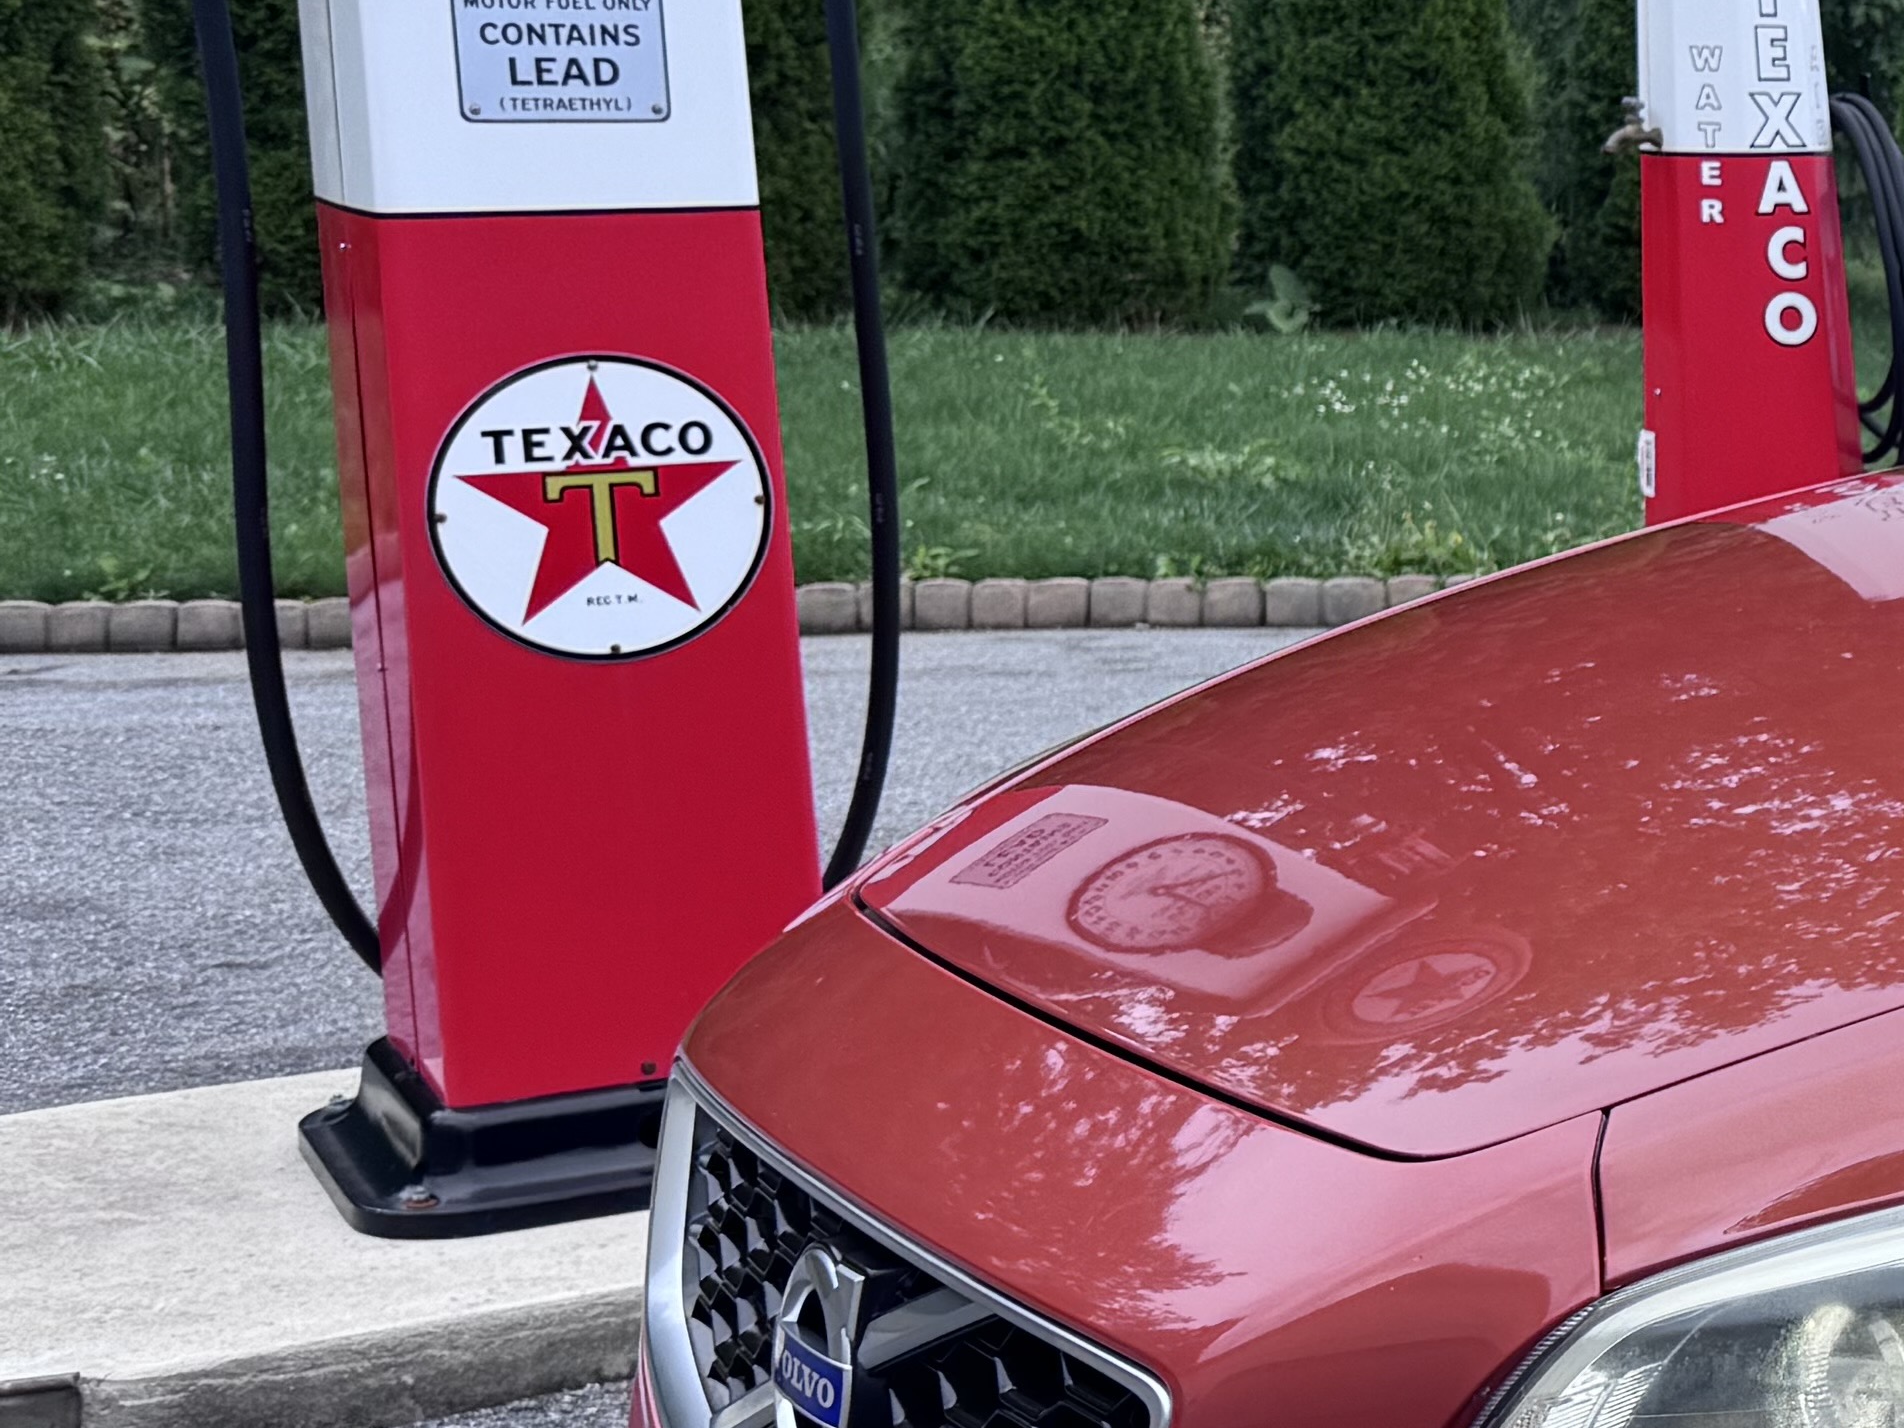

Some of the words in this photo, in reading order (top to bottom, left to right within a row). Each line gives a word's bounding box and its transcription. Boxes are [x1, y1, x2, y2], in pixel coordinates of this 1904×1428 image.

[479, 22, 641, 47] CONTAINS
[508, 56, 621, 87] LEAD
[1689, 45, 1725, 225] WATER
[480, 420, 713, 465] TEXACO
[777, 1348, 835, 1409] OLVO
